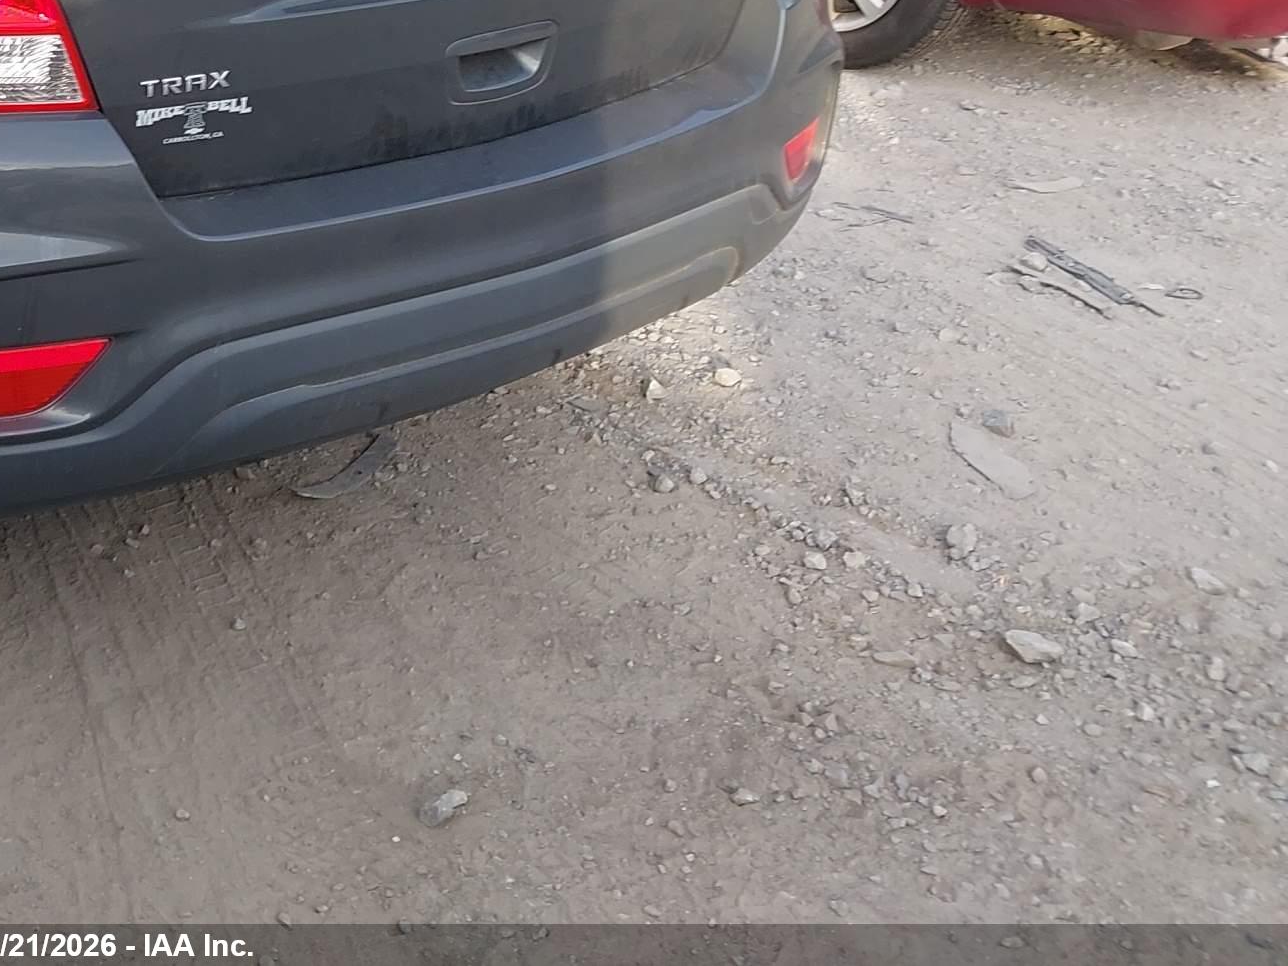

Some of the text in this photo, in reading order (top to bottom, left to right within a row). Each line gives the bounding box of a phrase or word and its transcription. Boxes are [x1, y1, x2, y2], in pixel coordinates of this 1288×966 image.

[139, 70, 231, 98] TRAX
[135, 97, 252, 127] MIKE BELL
